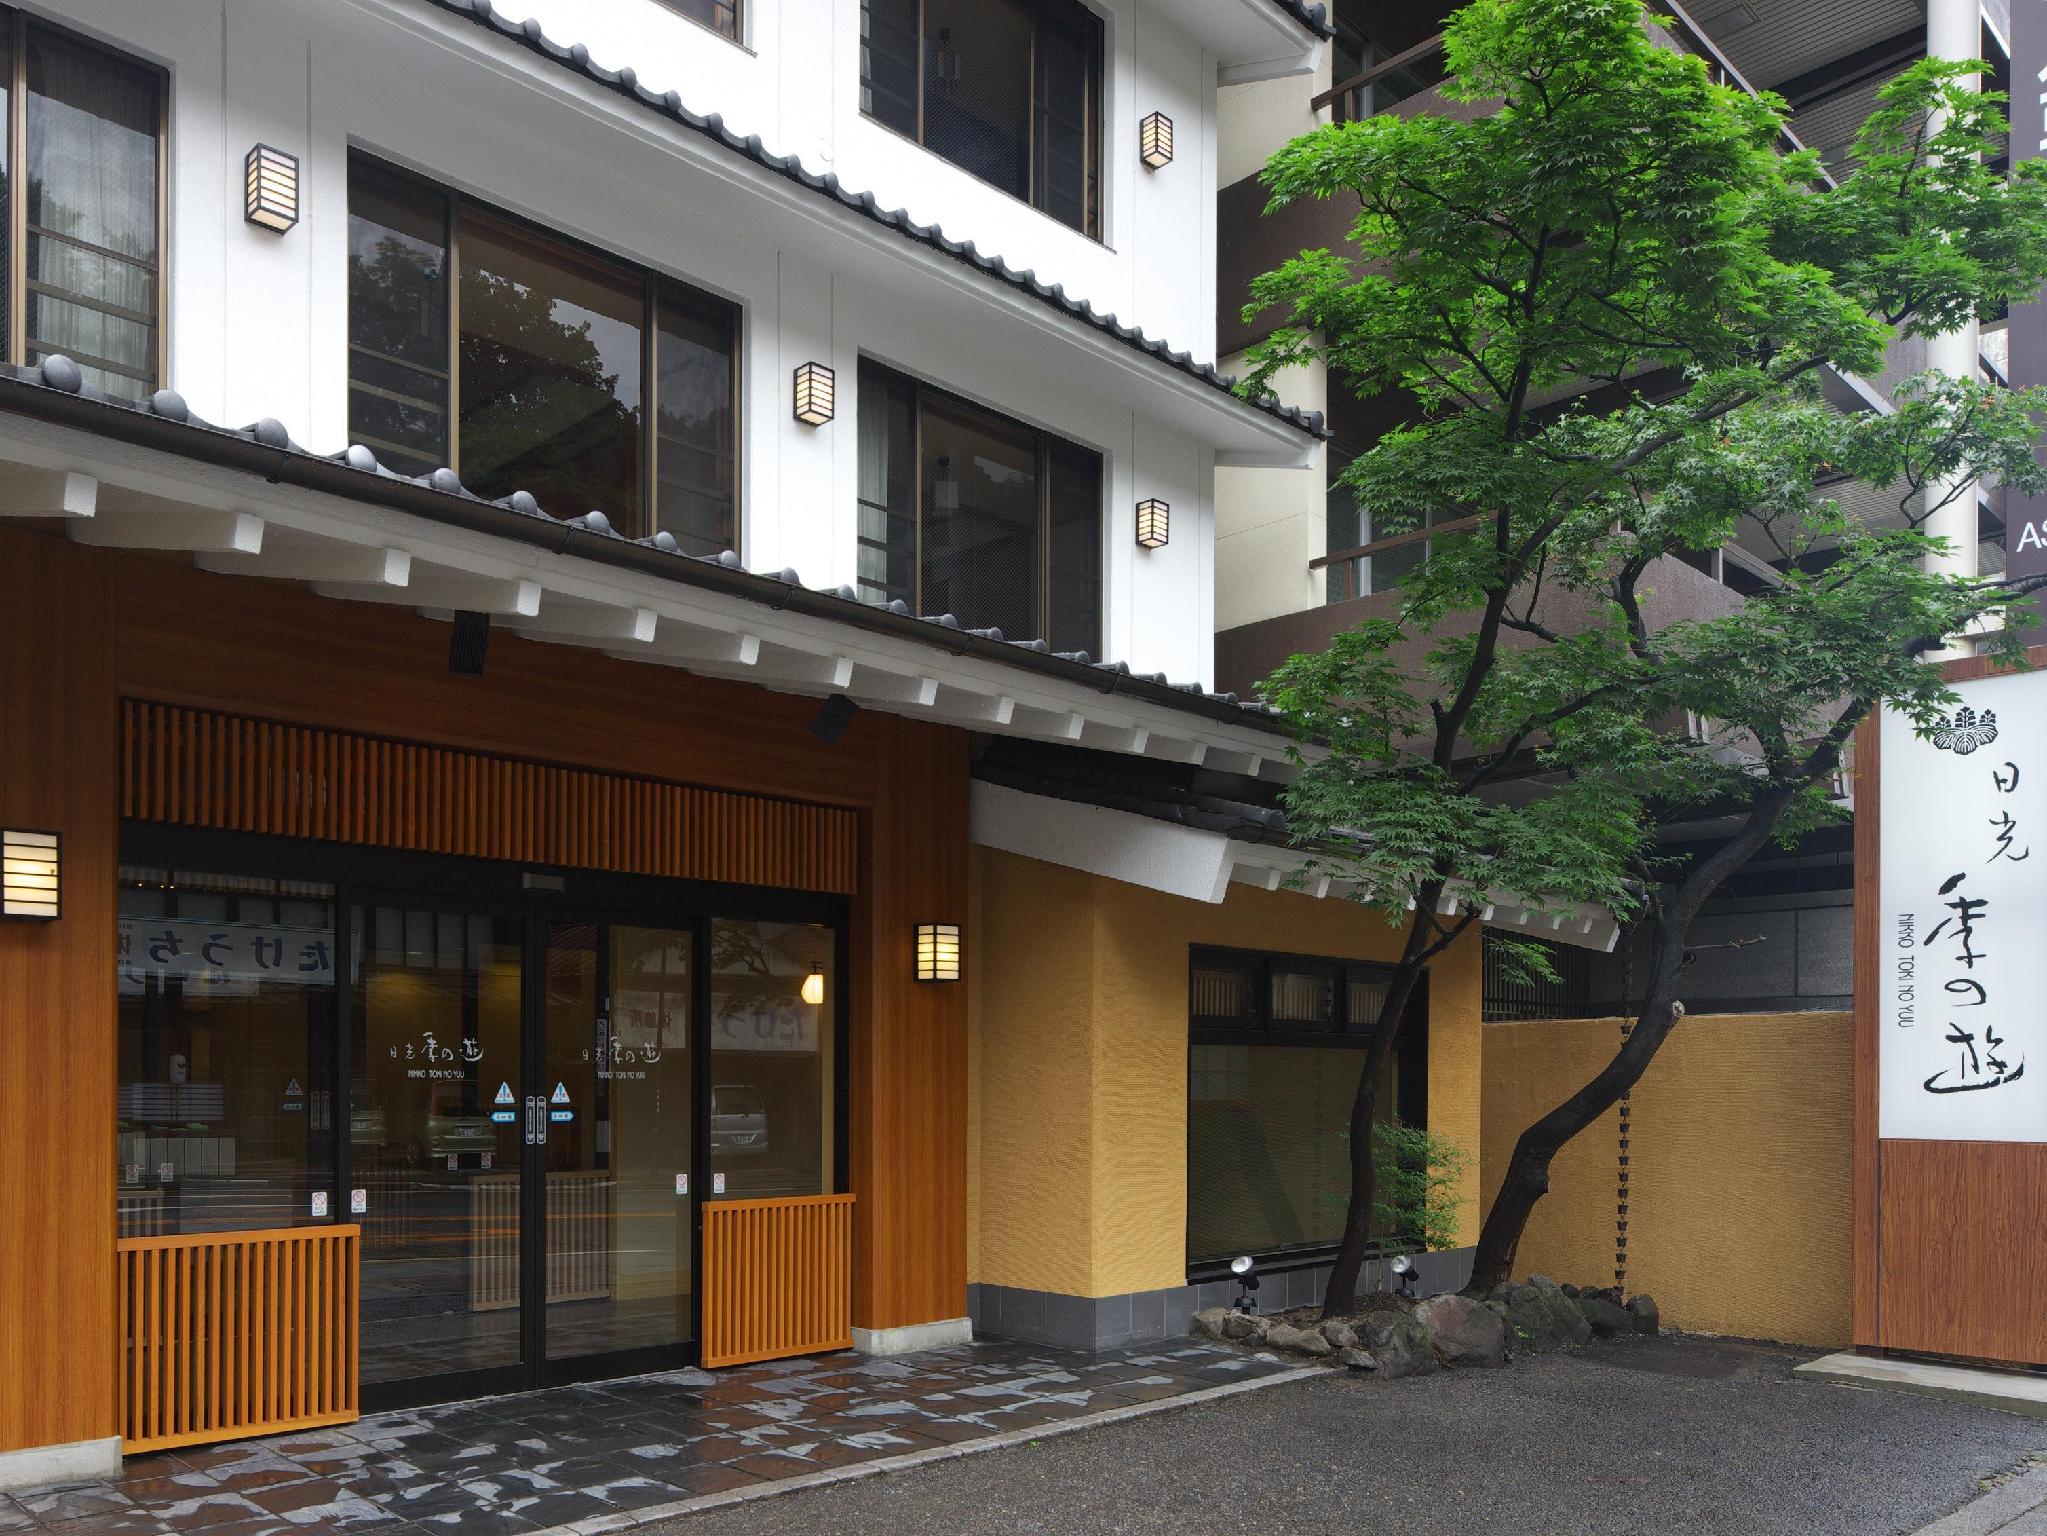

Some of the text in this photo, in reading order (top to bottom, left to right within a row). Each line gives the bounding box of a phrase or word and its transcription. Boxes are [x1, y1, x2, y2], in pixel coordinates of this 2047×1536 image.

[1898, 913, 1915, 1028] NIKKO TOKI NO YUU
[407, 1069, 465, 1079] NIKKO TOKI NO YUU
